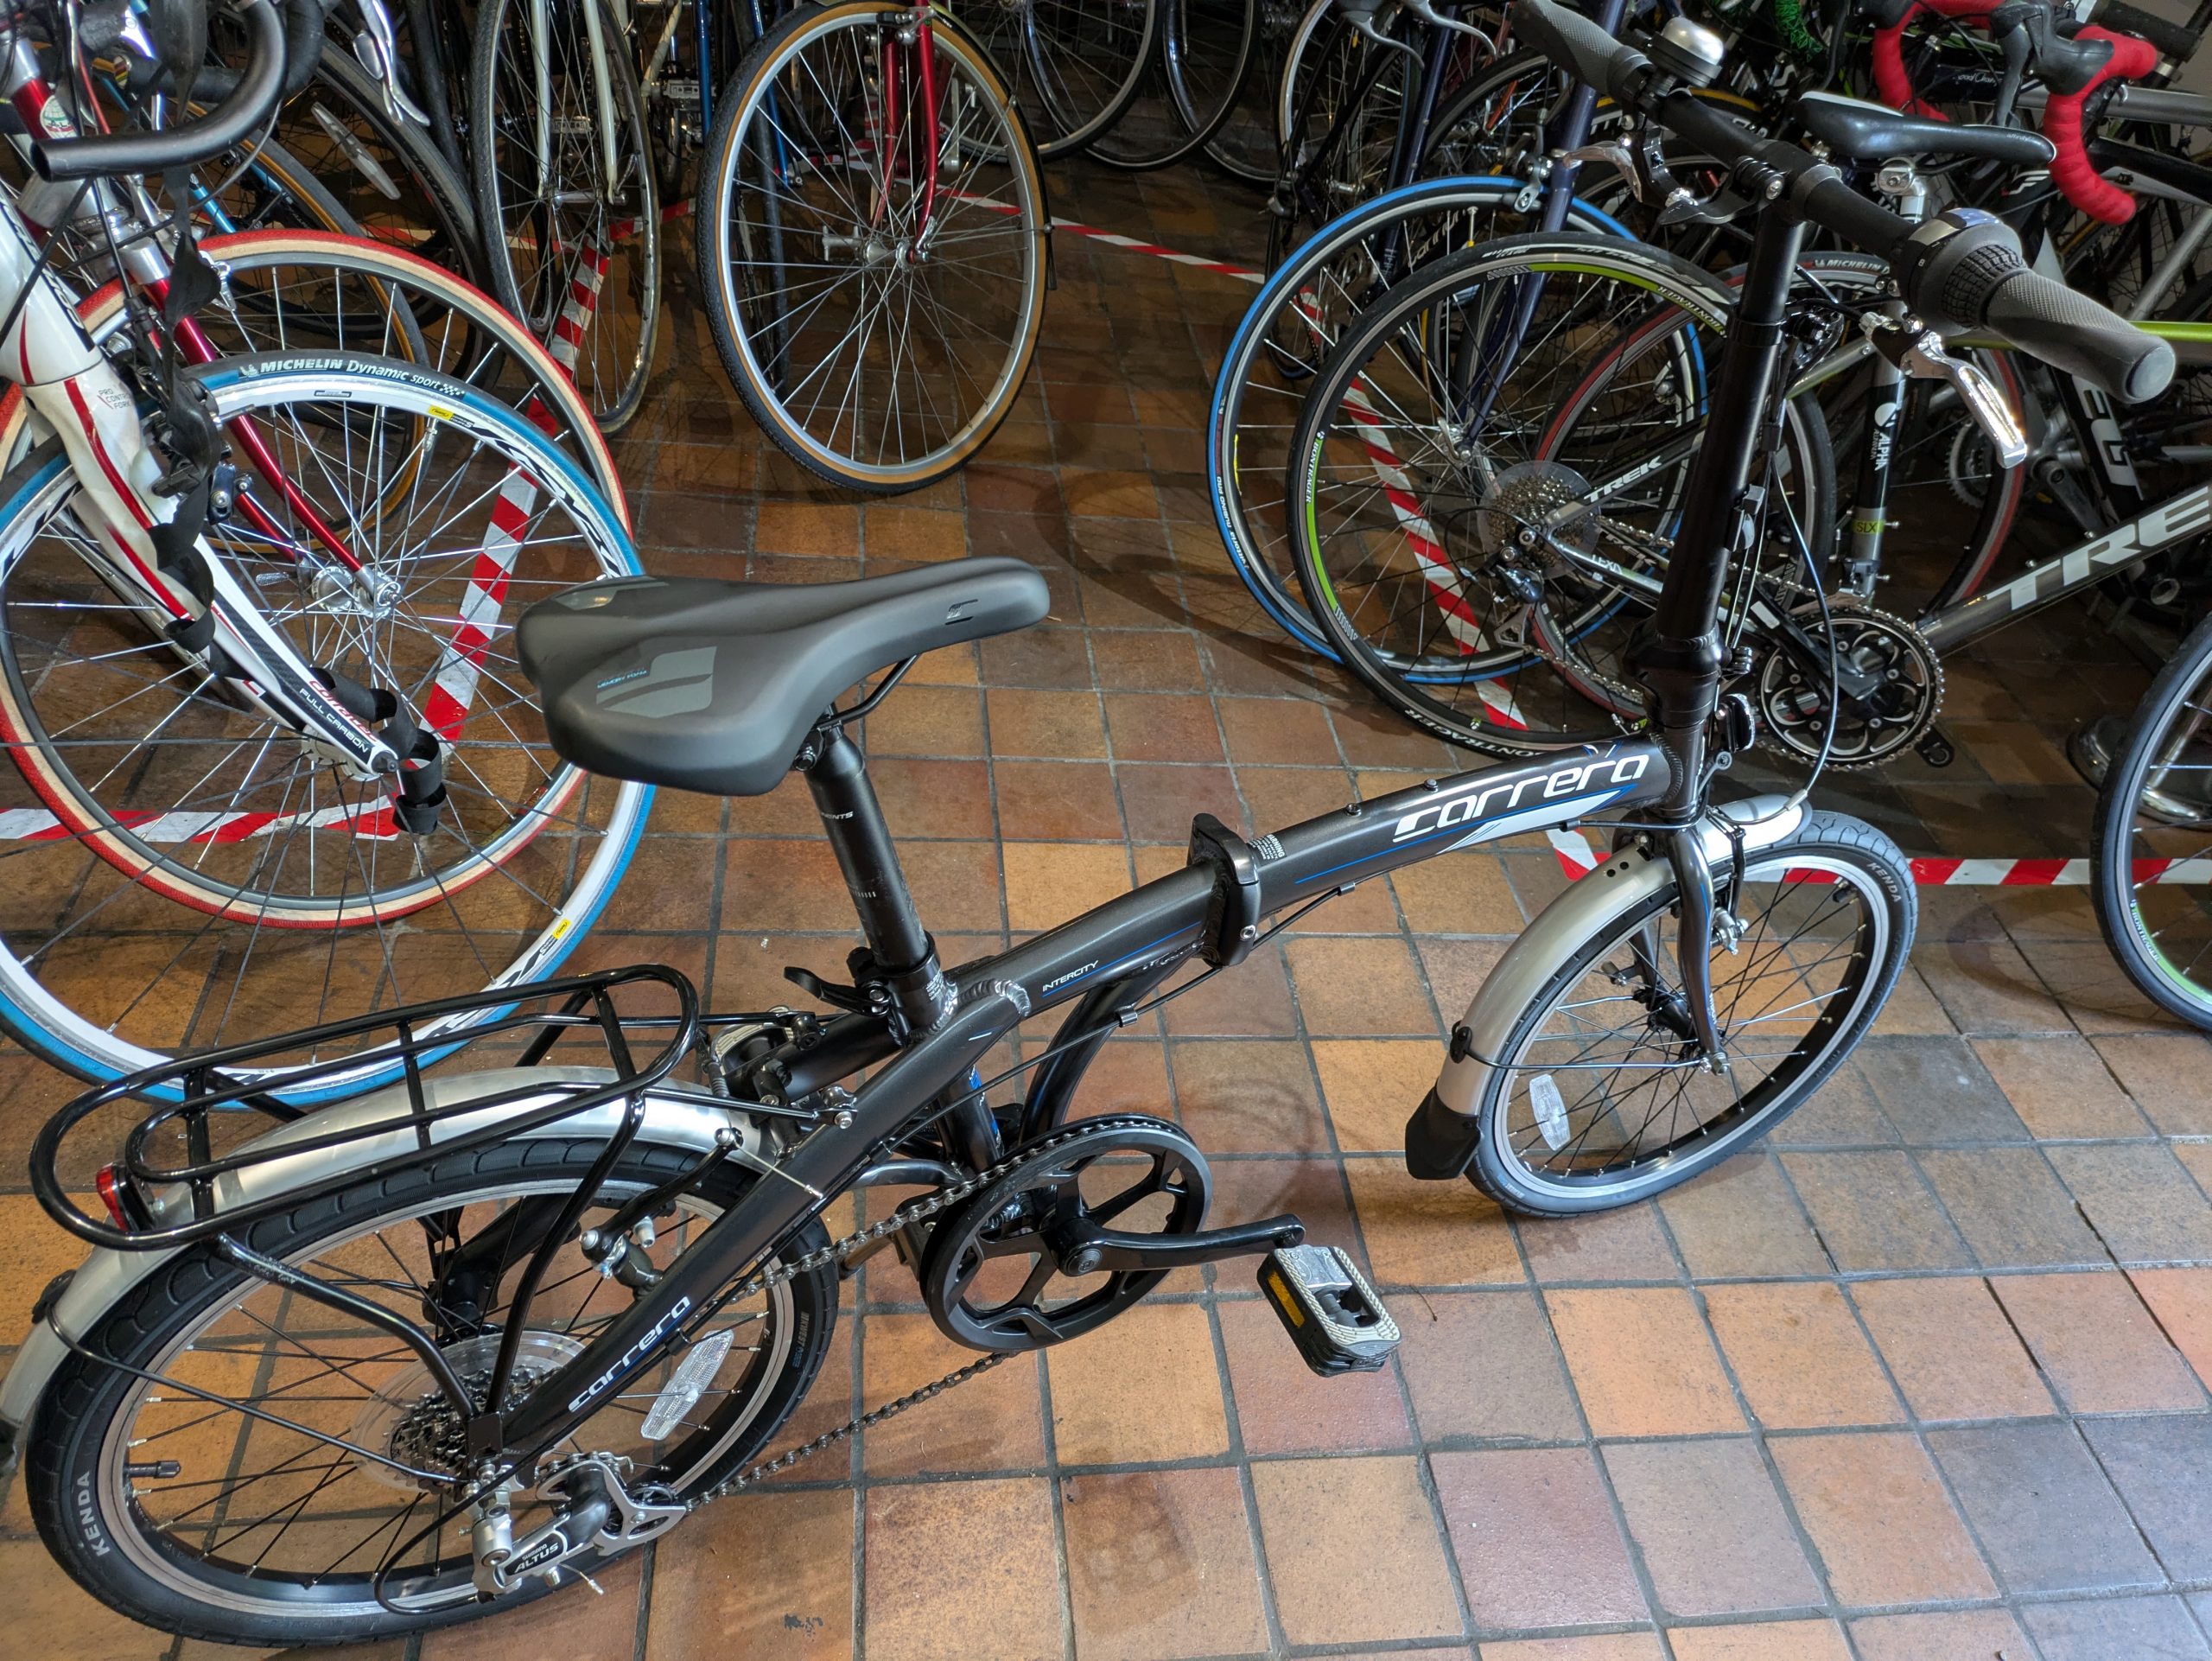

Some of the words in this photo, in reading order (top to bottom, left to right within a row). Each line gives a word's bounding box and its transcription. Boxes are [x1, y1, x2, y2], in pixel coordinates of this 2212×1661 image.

[1826, 259, 1883, 271] MICHELIN
[1657, 285, 1723, 331] BONTRAGER
[259, 358, 344, 373] MICHELIN
[346, 360, 410, 381] Dynamic
[410, 373, 442, 389] sport
[1306, 442, 1319, 504] BONTRAGER
[1873, 432, 1891, 471] ALPHA
[1583, 455, 1662, 503] TREK
[1857, 521, 1878, 533] SLX
[299, 687, 325, 715] FULL
[326, 713, 369, 754] CARBON
[1392, 754, 1649, 843] carrera
[1866, 862, 1902, 902] KENDA
[1042, 959, 1099, 992] INTERCITY
[568, 1295, 691, 1413] carrera
[76, 1470, 111, 1557] KENDA
[514, 1542, 559, 1574] ALTUS
